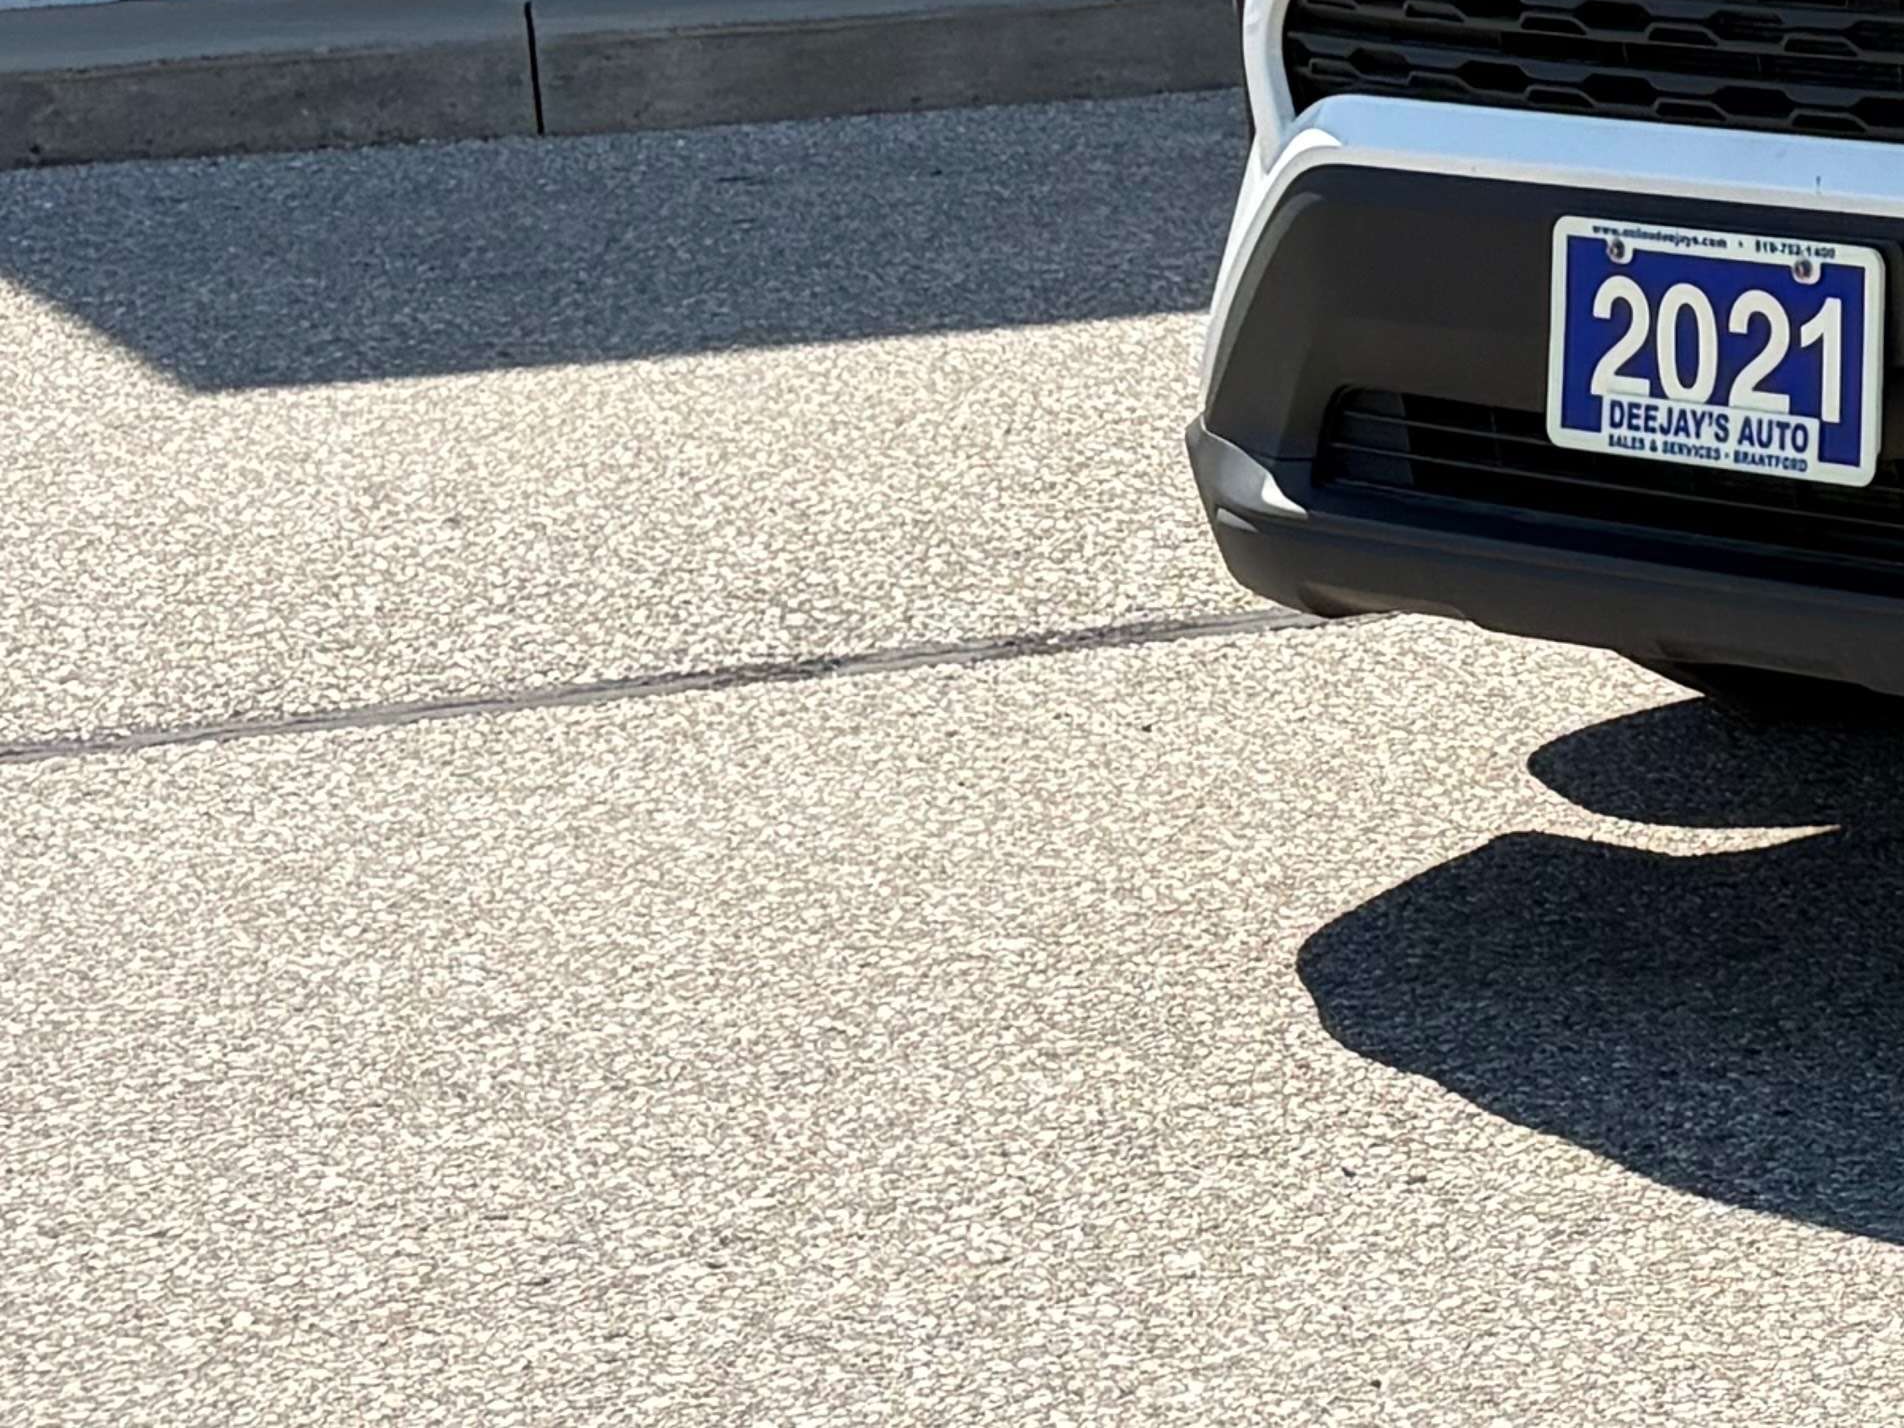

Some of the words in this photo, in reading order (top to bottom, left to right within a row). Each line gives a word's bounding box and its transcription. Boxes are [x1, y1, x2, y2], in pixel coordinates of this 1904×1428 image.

[1591, 275, 1842, 423] 2021
[1609, 400, 1729, 443] DEEJAY'S
[1738, 417, 1809, 453] AUTO
[1608, 434, 1645, 450] SALES
[1733, 450, 1808, 473] BRANTFORD
